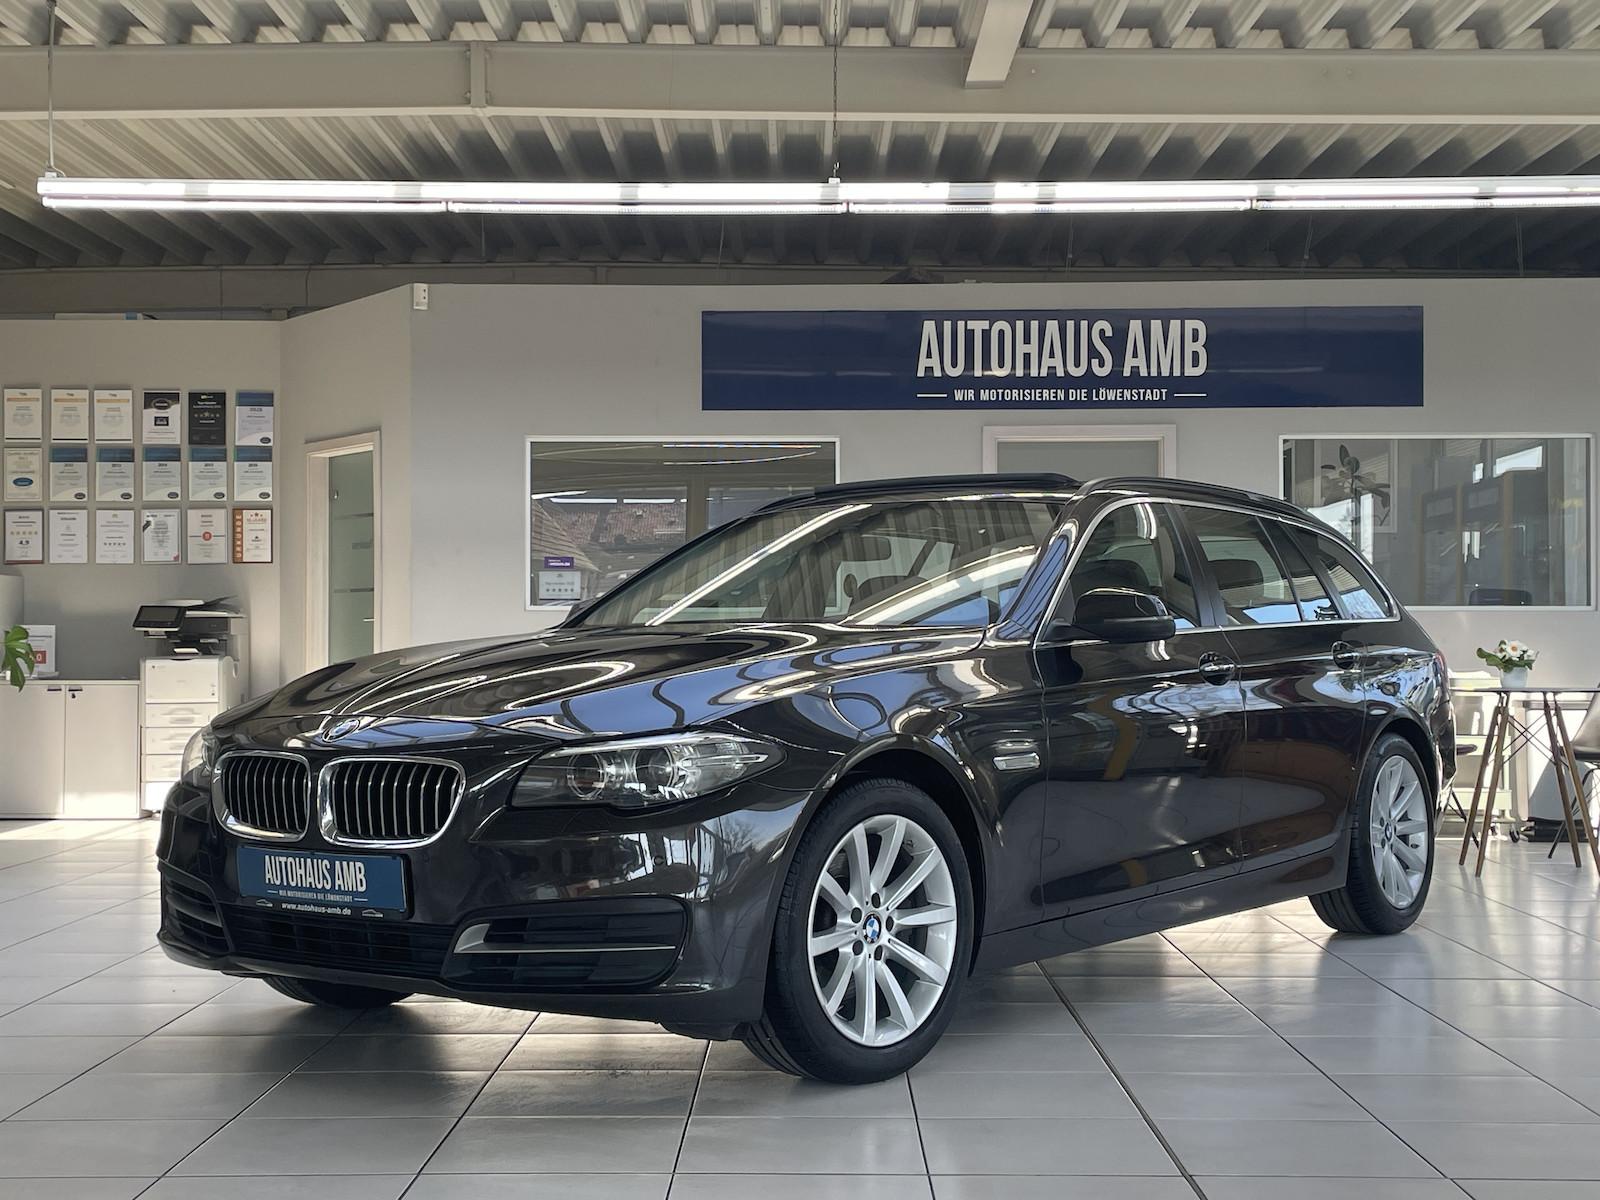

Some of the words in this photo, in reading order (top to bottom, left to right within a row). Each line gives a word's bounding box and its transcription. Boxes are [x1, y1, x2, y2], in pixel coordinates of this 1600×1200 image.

[916, 319, 1113, 378] AUTOHAUS
[1122, 319, 1208, 378] AMB
[954, 389, 975, 401] WIR
[980, 389, 1065, 401] MOTORISIEREN
[1069, 389, 1088, 401] DIE
[1092, 387, 1168, 401] LÖWENSTADT
[264, 854, 332, 890] AUTOHAUS
[334, 860, 367, 893] AMB
[281, 902, 352, 916] www.autohaus-amb.de
